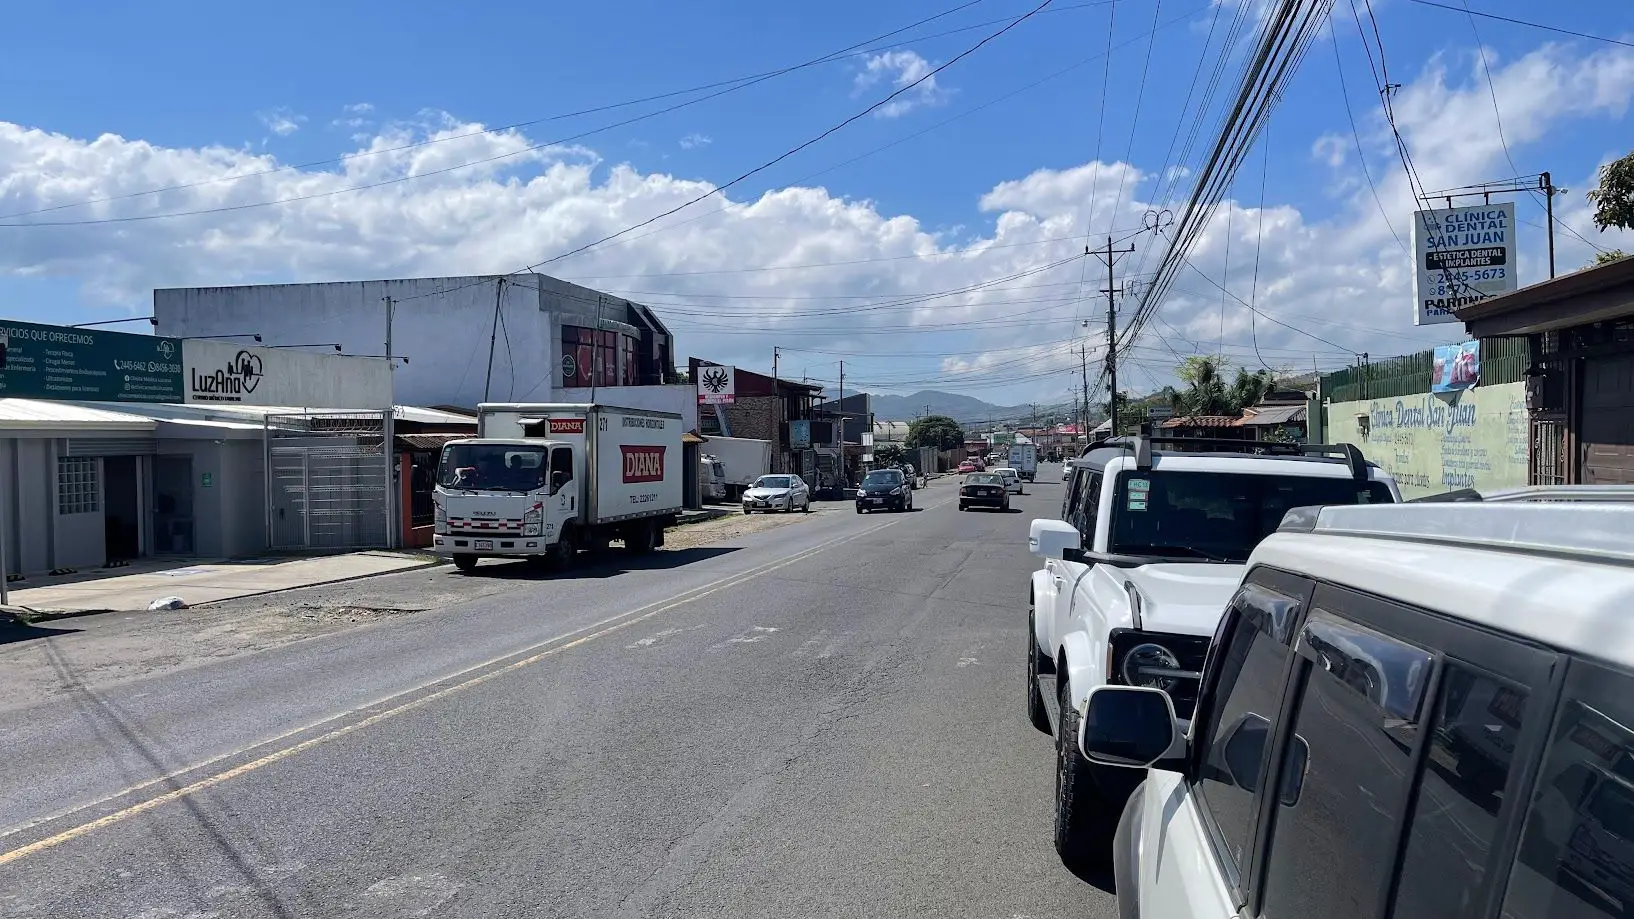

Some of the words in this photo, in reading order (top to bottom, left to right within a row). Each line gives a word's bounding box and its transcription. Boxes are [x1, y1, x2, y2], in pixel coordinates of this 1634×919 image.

[1445, 210, 1507, 223] CLÍNICA
[1445, 220, 1507, 233] DENTAL
[1427, 235, 1459, 248] SAN
[1462, 231, 1504, 246] JUAN
[1470, 248, 1503, 258] DENTAL
[1445, 257, 1491, 267] IMPLANTES
[30, 330, 47, 341] QUE
[49, 331, 94, 345] OFRECEMOS
[192, 367, 241, 393] LuzAna
[1396, 399, 1425, 429] Dental
[1426, 392, 1445, 431] San
[551, 421, 583, 431] DIANA
[625, 452, 662, 477] DIANA
